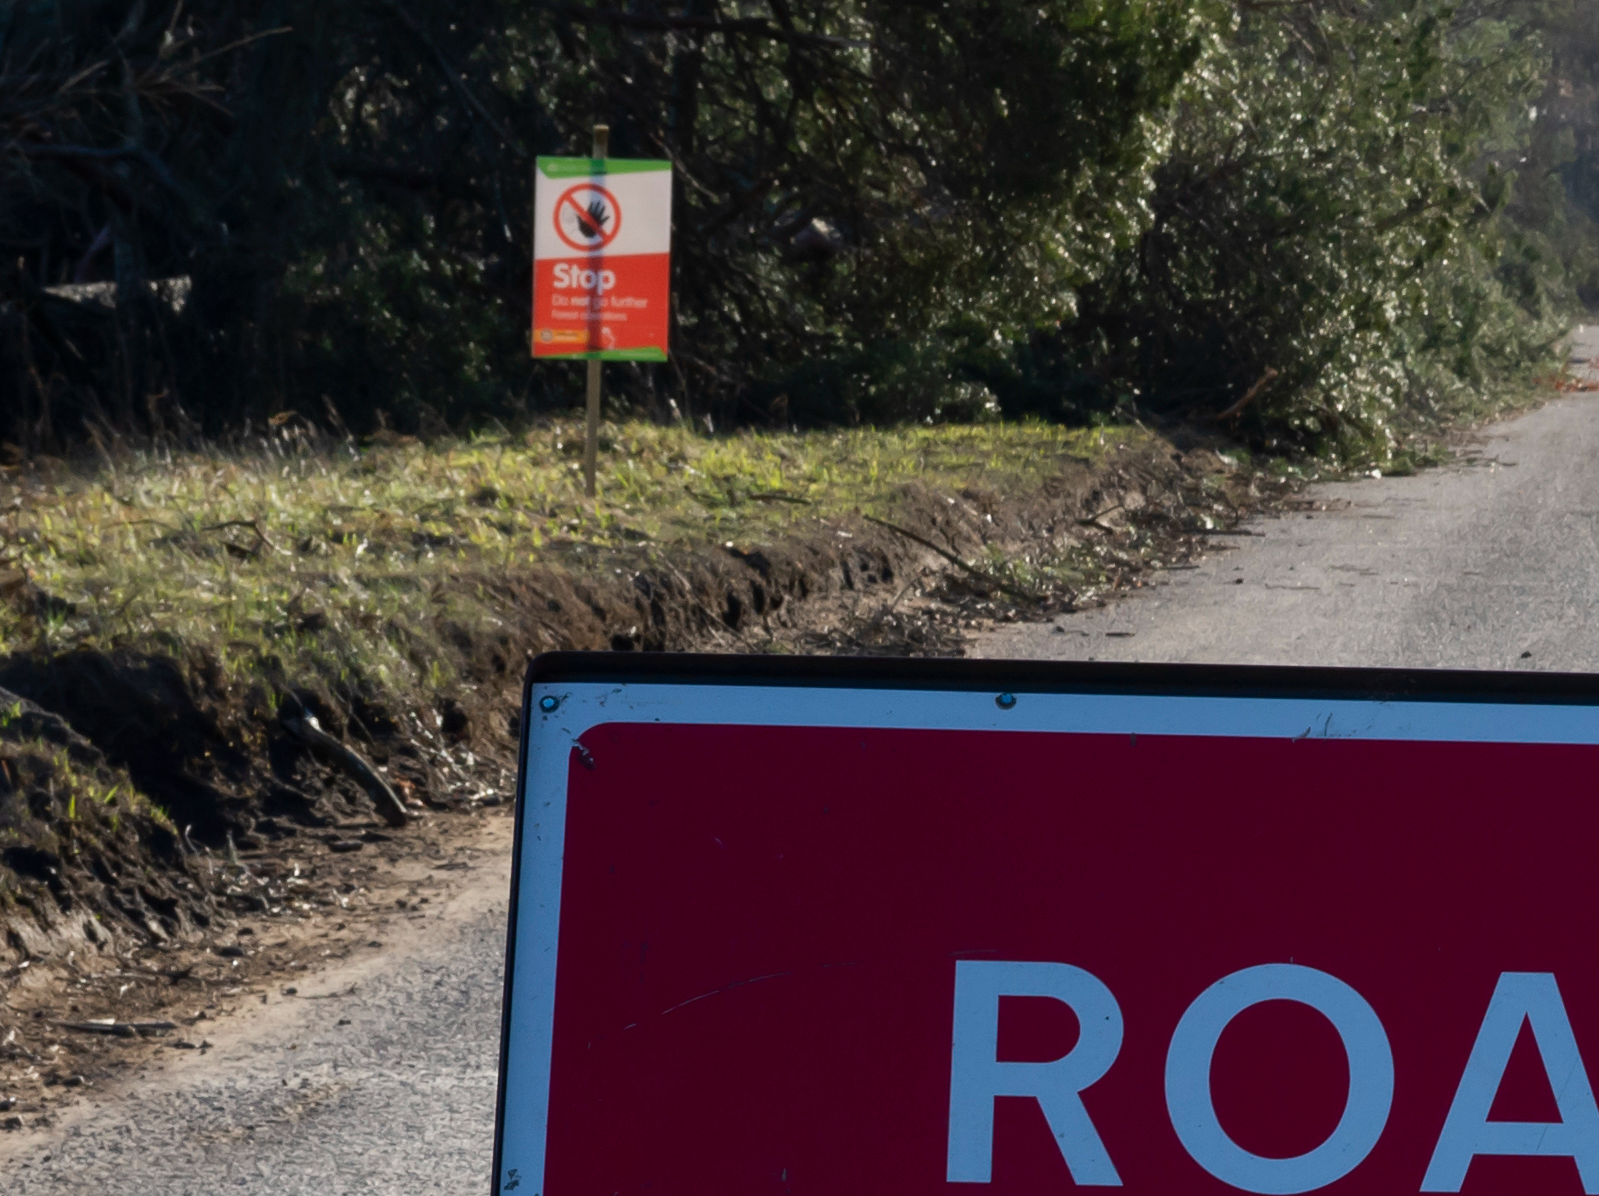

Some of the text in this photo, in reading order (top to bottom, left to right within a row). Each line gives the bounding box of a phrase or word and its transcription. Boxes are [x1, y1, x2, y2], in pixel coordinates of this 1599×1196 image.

[553, 262, 616, 295] Stop
[552, 295, 569, 306] Do
[611, 296, 648, 309] further
